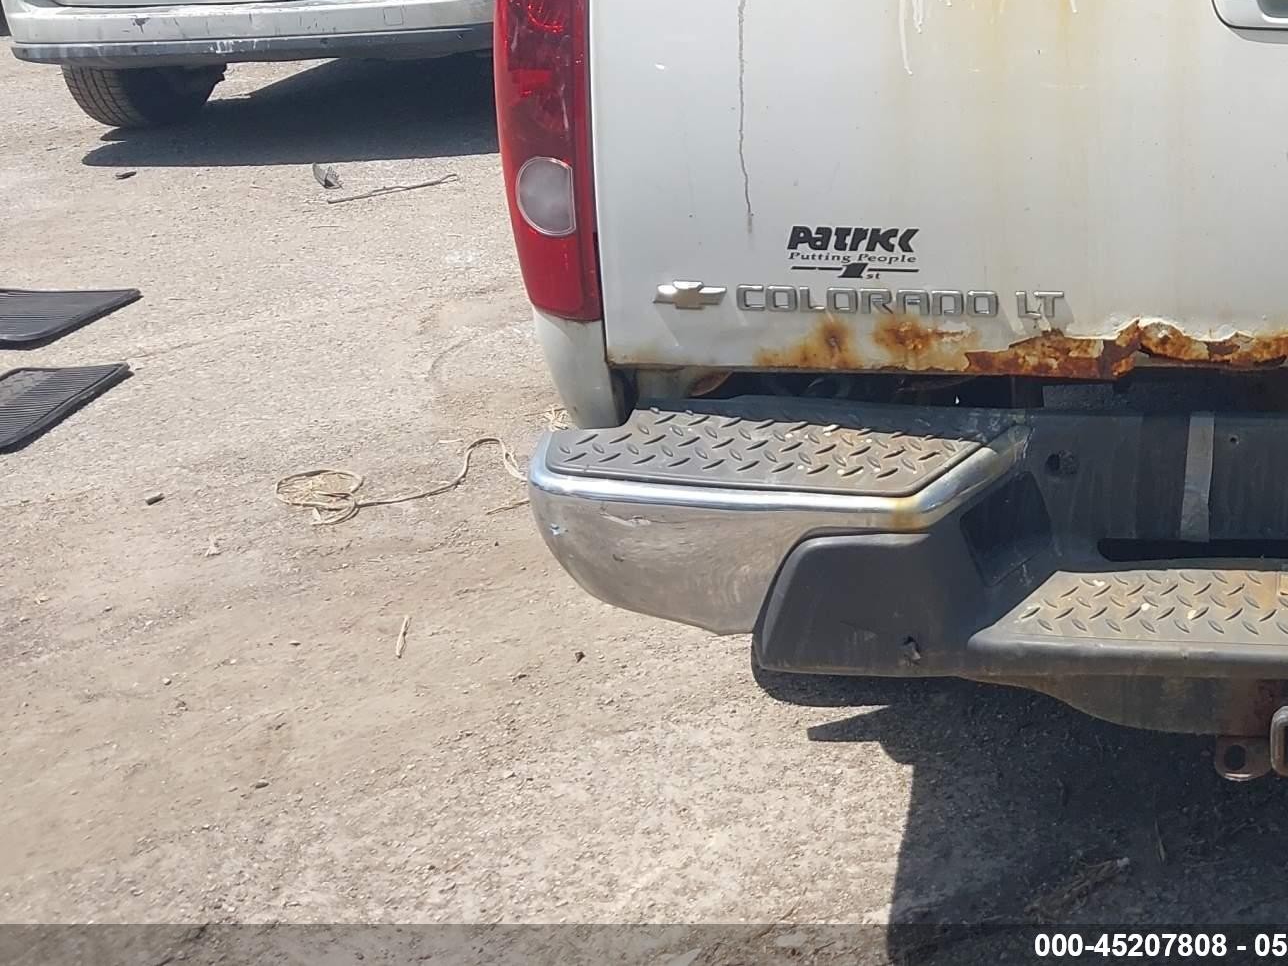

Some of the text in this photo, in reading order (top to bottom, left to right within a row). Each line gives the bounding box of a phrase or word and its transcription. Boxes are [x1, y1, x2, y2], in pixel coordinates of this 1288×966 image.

[788, 251, 918, 265] Putting People
[735, 284, 1065, 319] COLORADO LT
